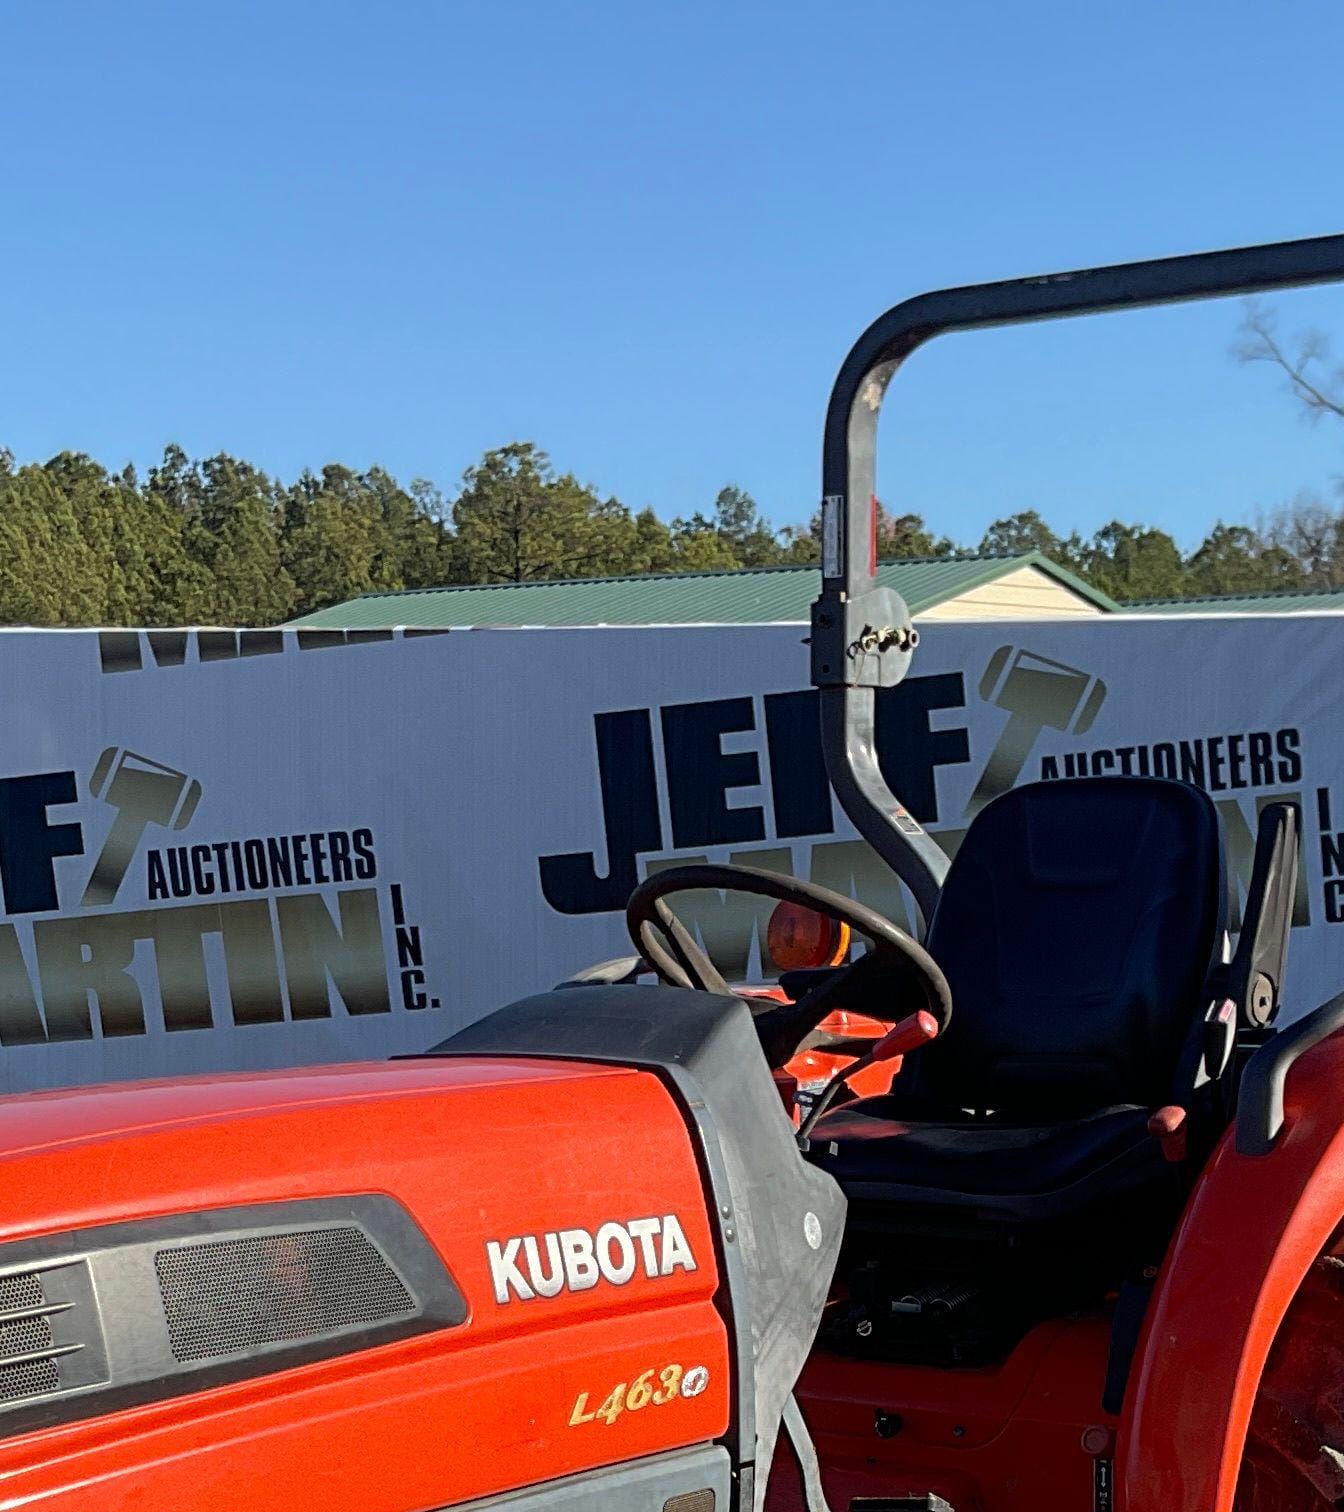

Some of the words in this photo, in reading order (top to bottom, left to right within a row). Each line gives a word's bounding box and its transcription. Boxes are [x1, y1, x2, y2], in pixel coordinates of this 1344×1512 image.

[538, 671, 971, 915] JEFF
[148, 828, 377, 901] AUCTIONEERS
[390, 884, 440, 1012] INC.
[485, 1213, 697, 1304] KUBOTA
[568, 1363, 709, 1427] L4630
